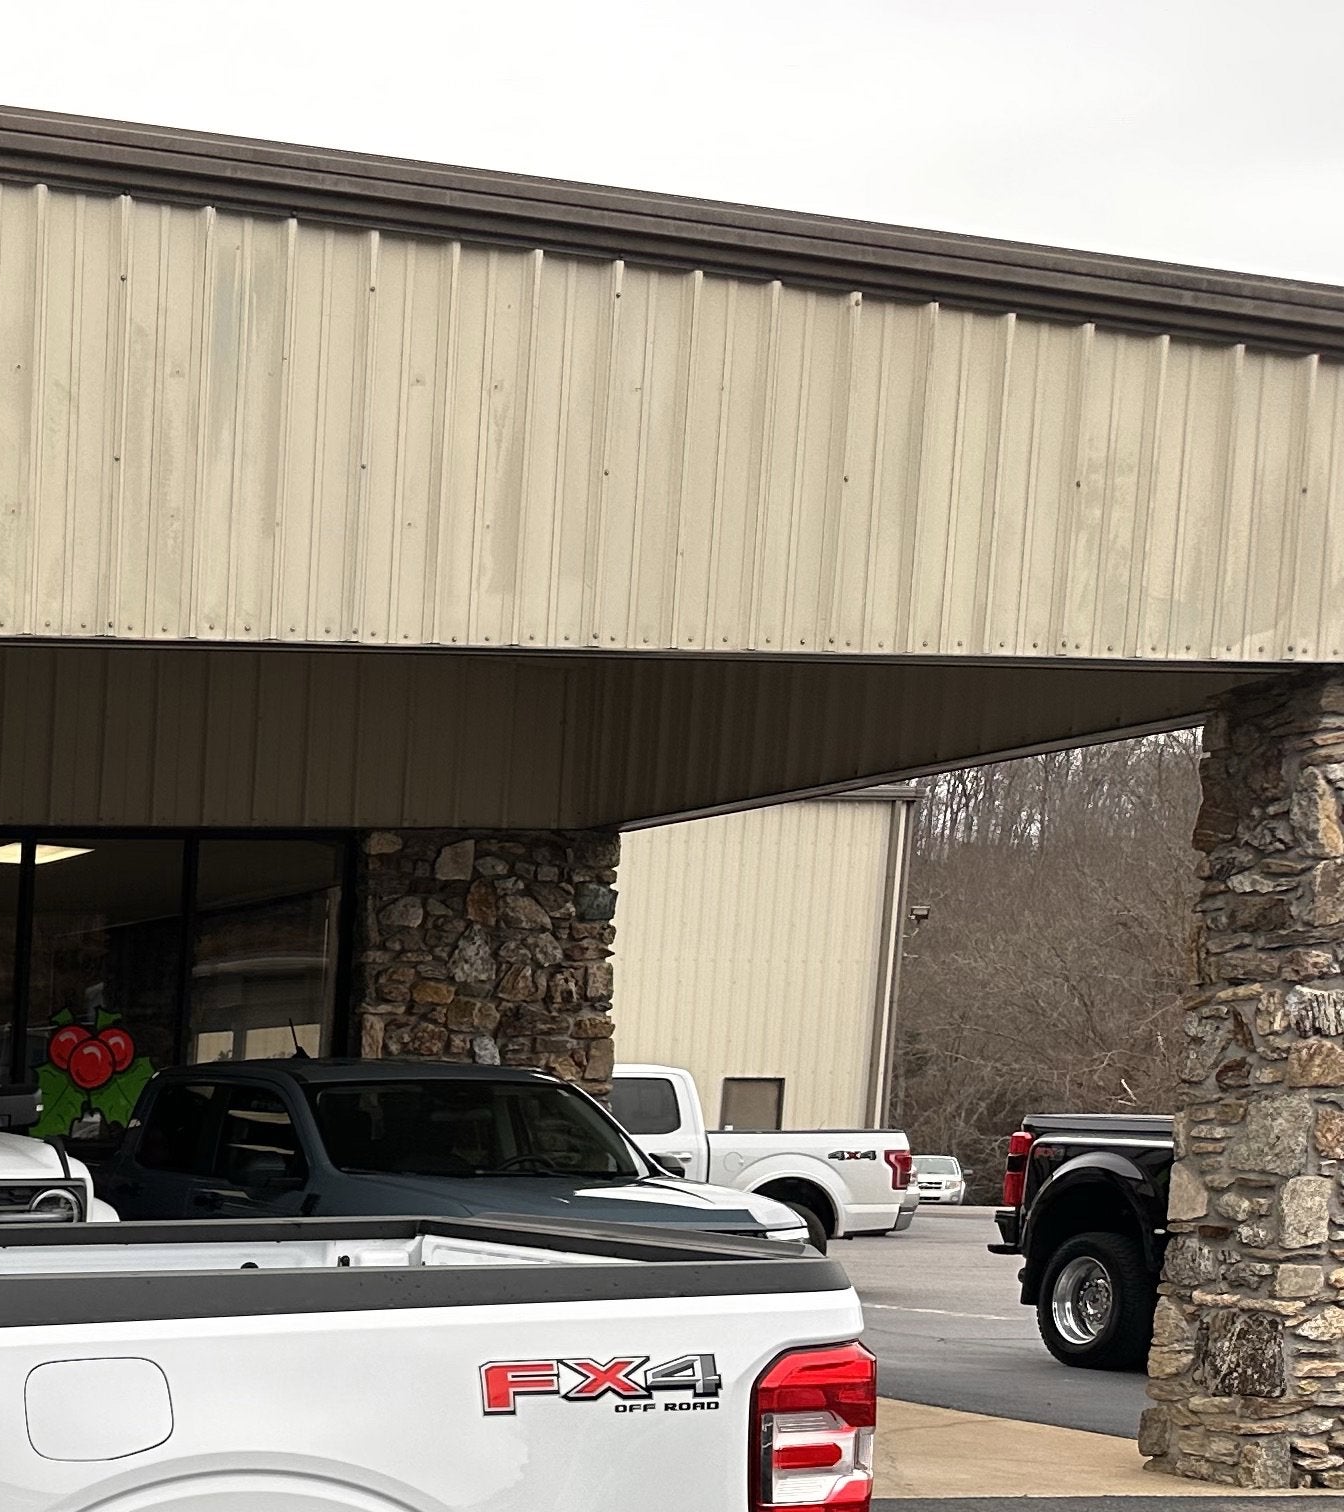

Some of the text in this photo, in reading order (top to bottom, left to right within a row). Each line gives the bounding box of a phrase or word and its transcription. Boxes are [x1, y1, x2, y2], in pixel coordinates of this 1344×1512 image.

[478, 1353, 724, 1416] FX4
[614, 1400, 720, 1413] OFF ROAD
